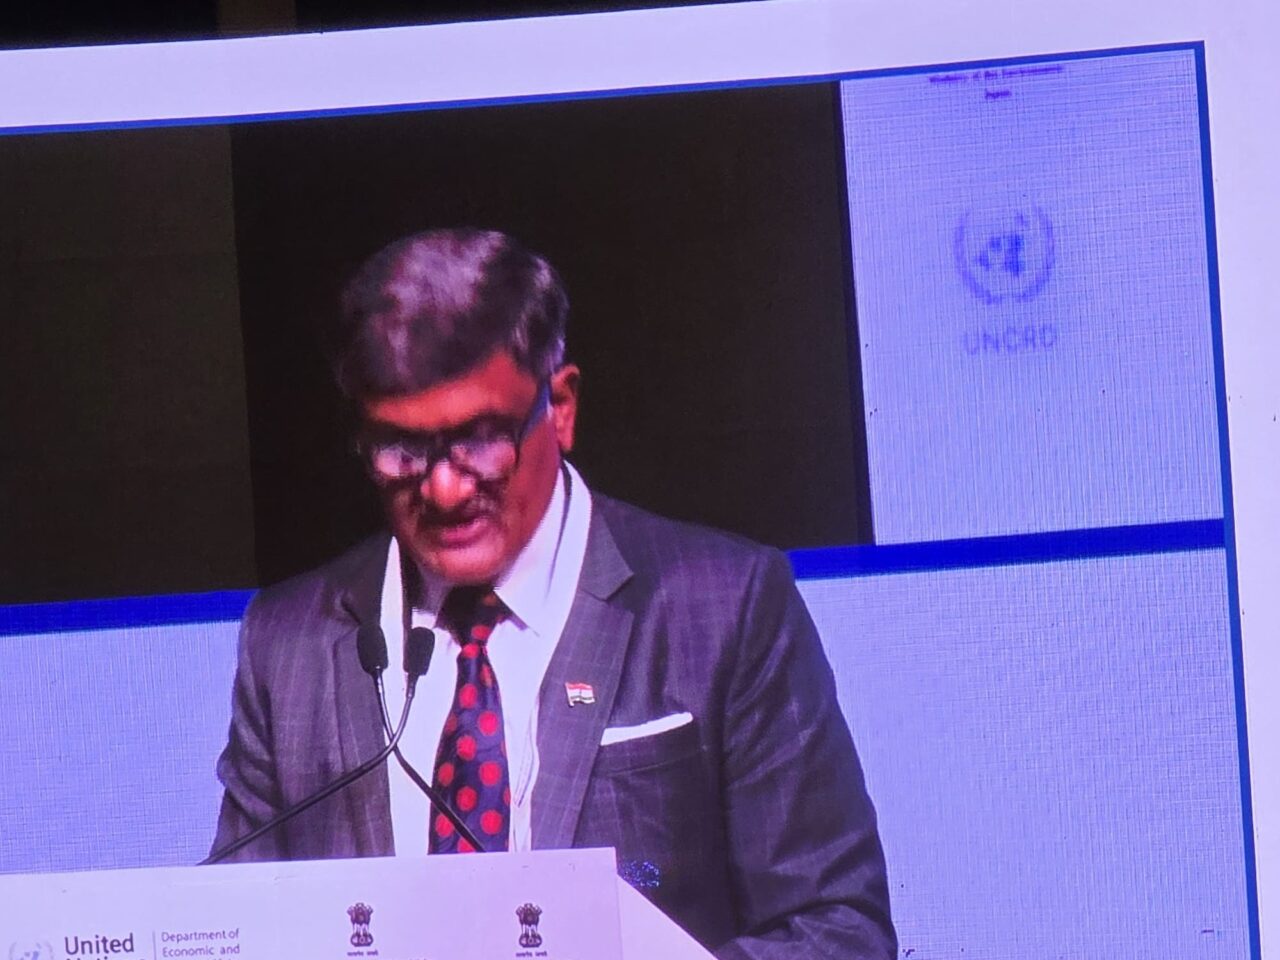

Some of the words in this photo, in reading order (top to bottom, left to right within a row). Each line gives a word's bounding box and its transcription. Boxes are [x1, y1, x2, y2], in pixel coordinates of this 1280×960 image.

[161, 930, 225, 943] Department
[227, 928, 239, 939] of
[65, 933, 134, 955] United
[162, 947, 214, 957] Economic
[220, 944, 240, 954] and
